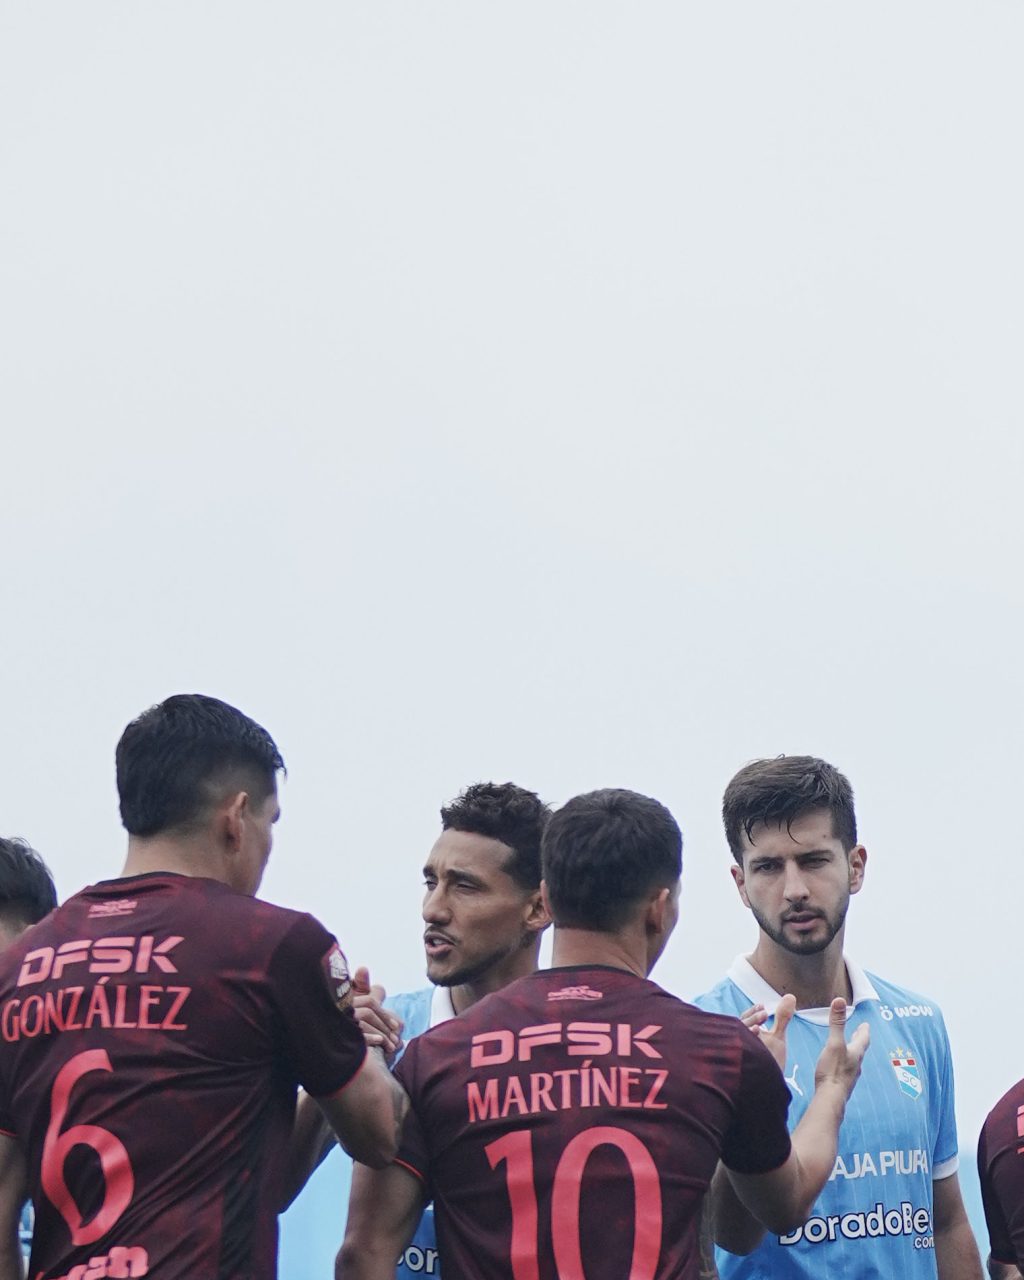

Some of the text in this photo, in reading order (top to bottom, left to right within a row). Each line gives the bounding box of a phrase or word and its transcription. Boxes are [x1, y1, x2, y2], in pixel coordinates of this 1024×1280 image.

[16, 935, 186, 988] DFSK
[2, 976, 192, 1042] GONZÁLEZ
[470, 1022, 663, 1069] DFSK
[467, 1059, 669, 1123] MARTÍNEZ
[41, 1048, 135, 1246] 6
[828, 1152, 878, 1182] AJA
[780, 1201, 934, 1246] oradoBe
